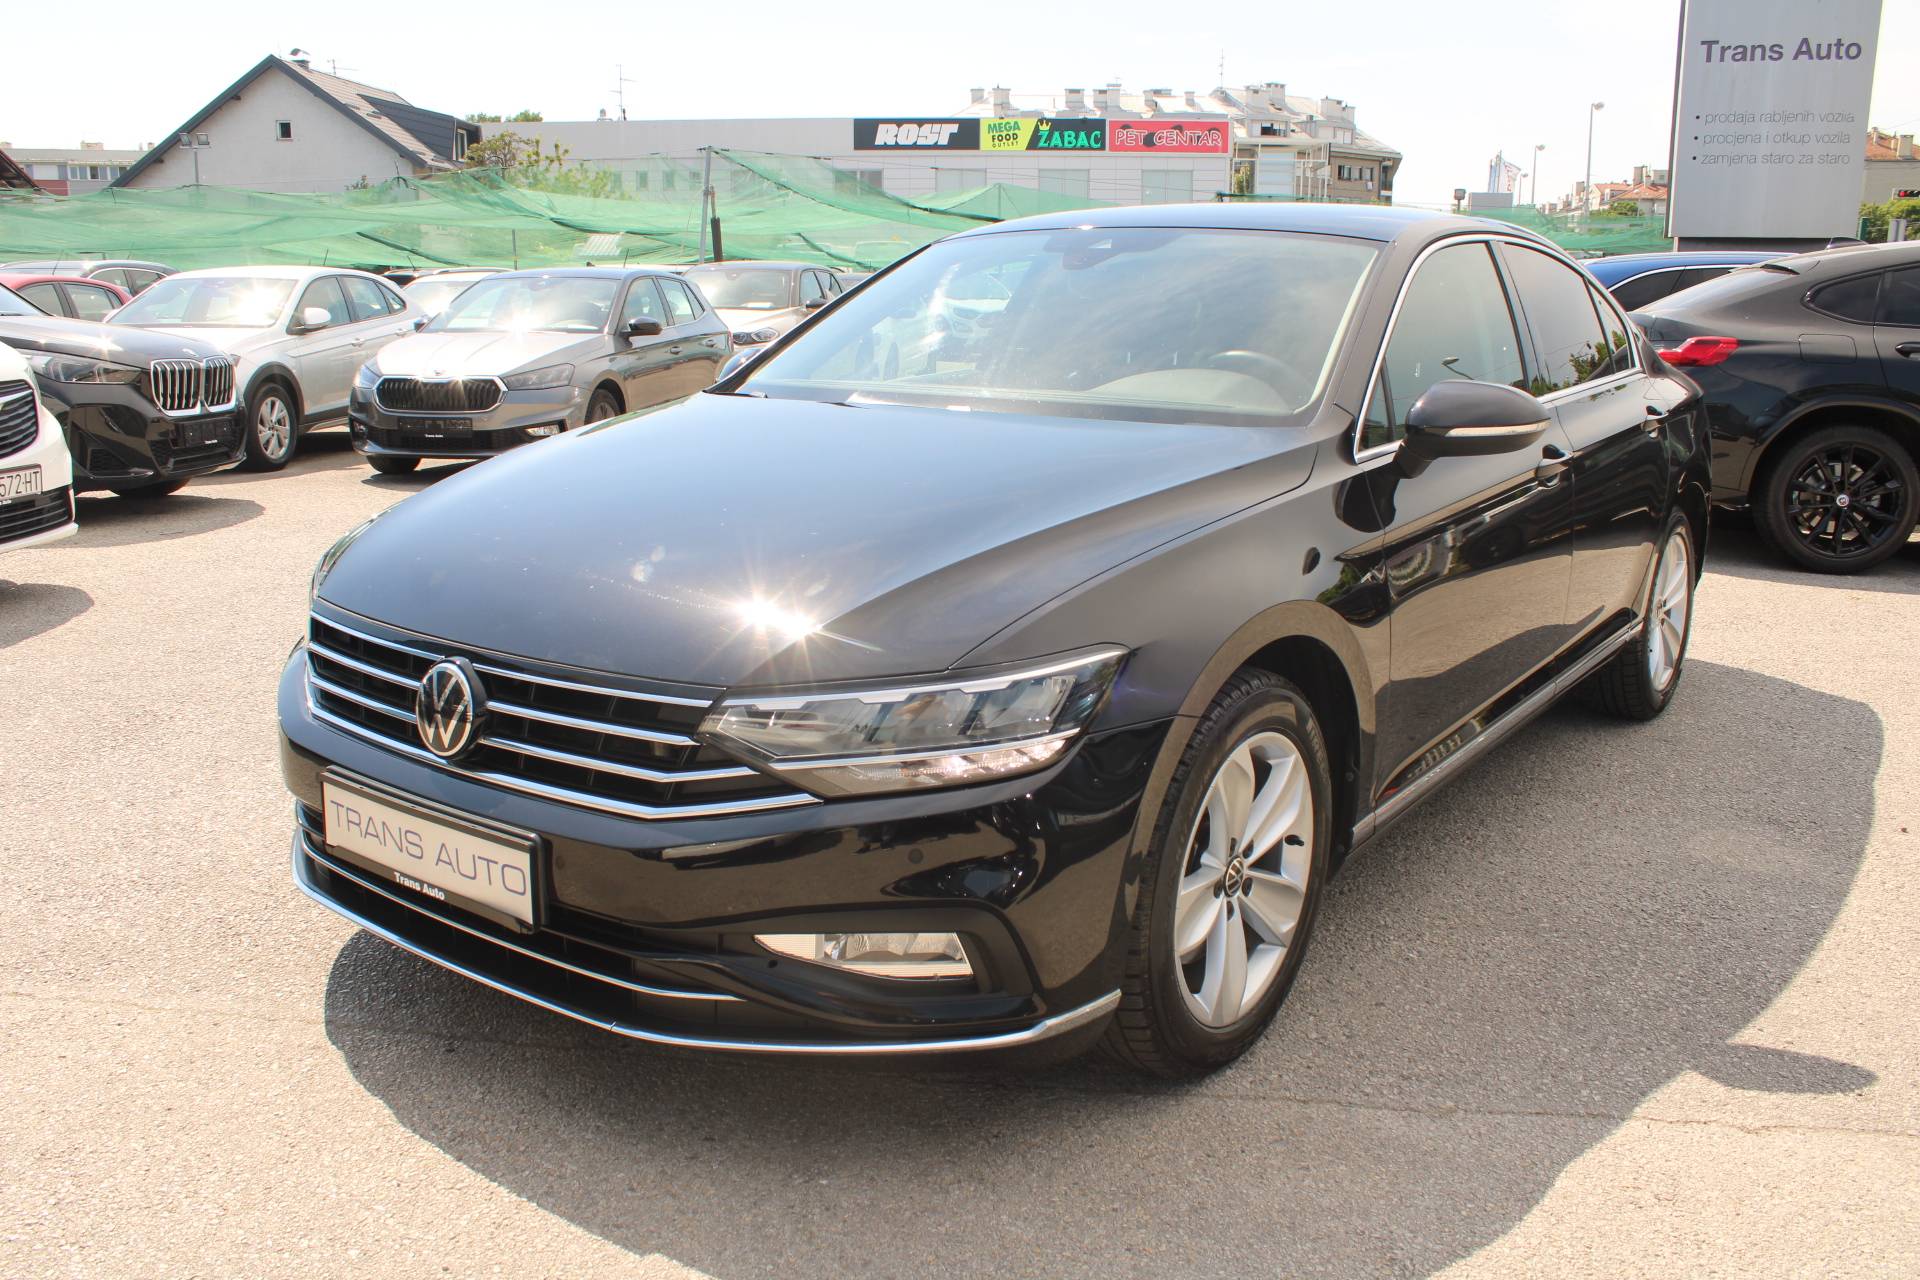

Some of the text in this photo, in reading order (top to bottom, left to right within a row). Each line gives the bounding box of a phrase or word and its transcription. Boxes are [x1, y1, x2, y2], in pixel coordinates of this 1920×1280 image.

[1700, 37, 1862, 63] Trans Auto
[1704, 110, 1855, 126] prodaja rabljenih vozila
[987, 120, 1021, 134] MEGA
[992, 133, 1018, 142] FOOD
[1115, 129, 1221, 146] PET CENTAR
[1703, 132, 1761, 146] procjena
[1773, 131, 1811, 145] otkup
[1815, 131, 1850, 144] vozila
[1700, 152, 1850, 167] zamjena staro za staro
[330, 800, 526, 896] TRANS AUTO
[394, 871, 445, 900] Trans Auto
